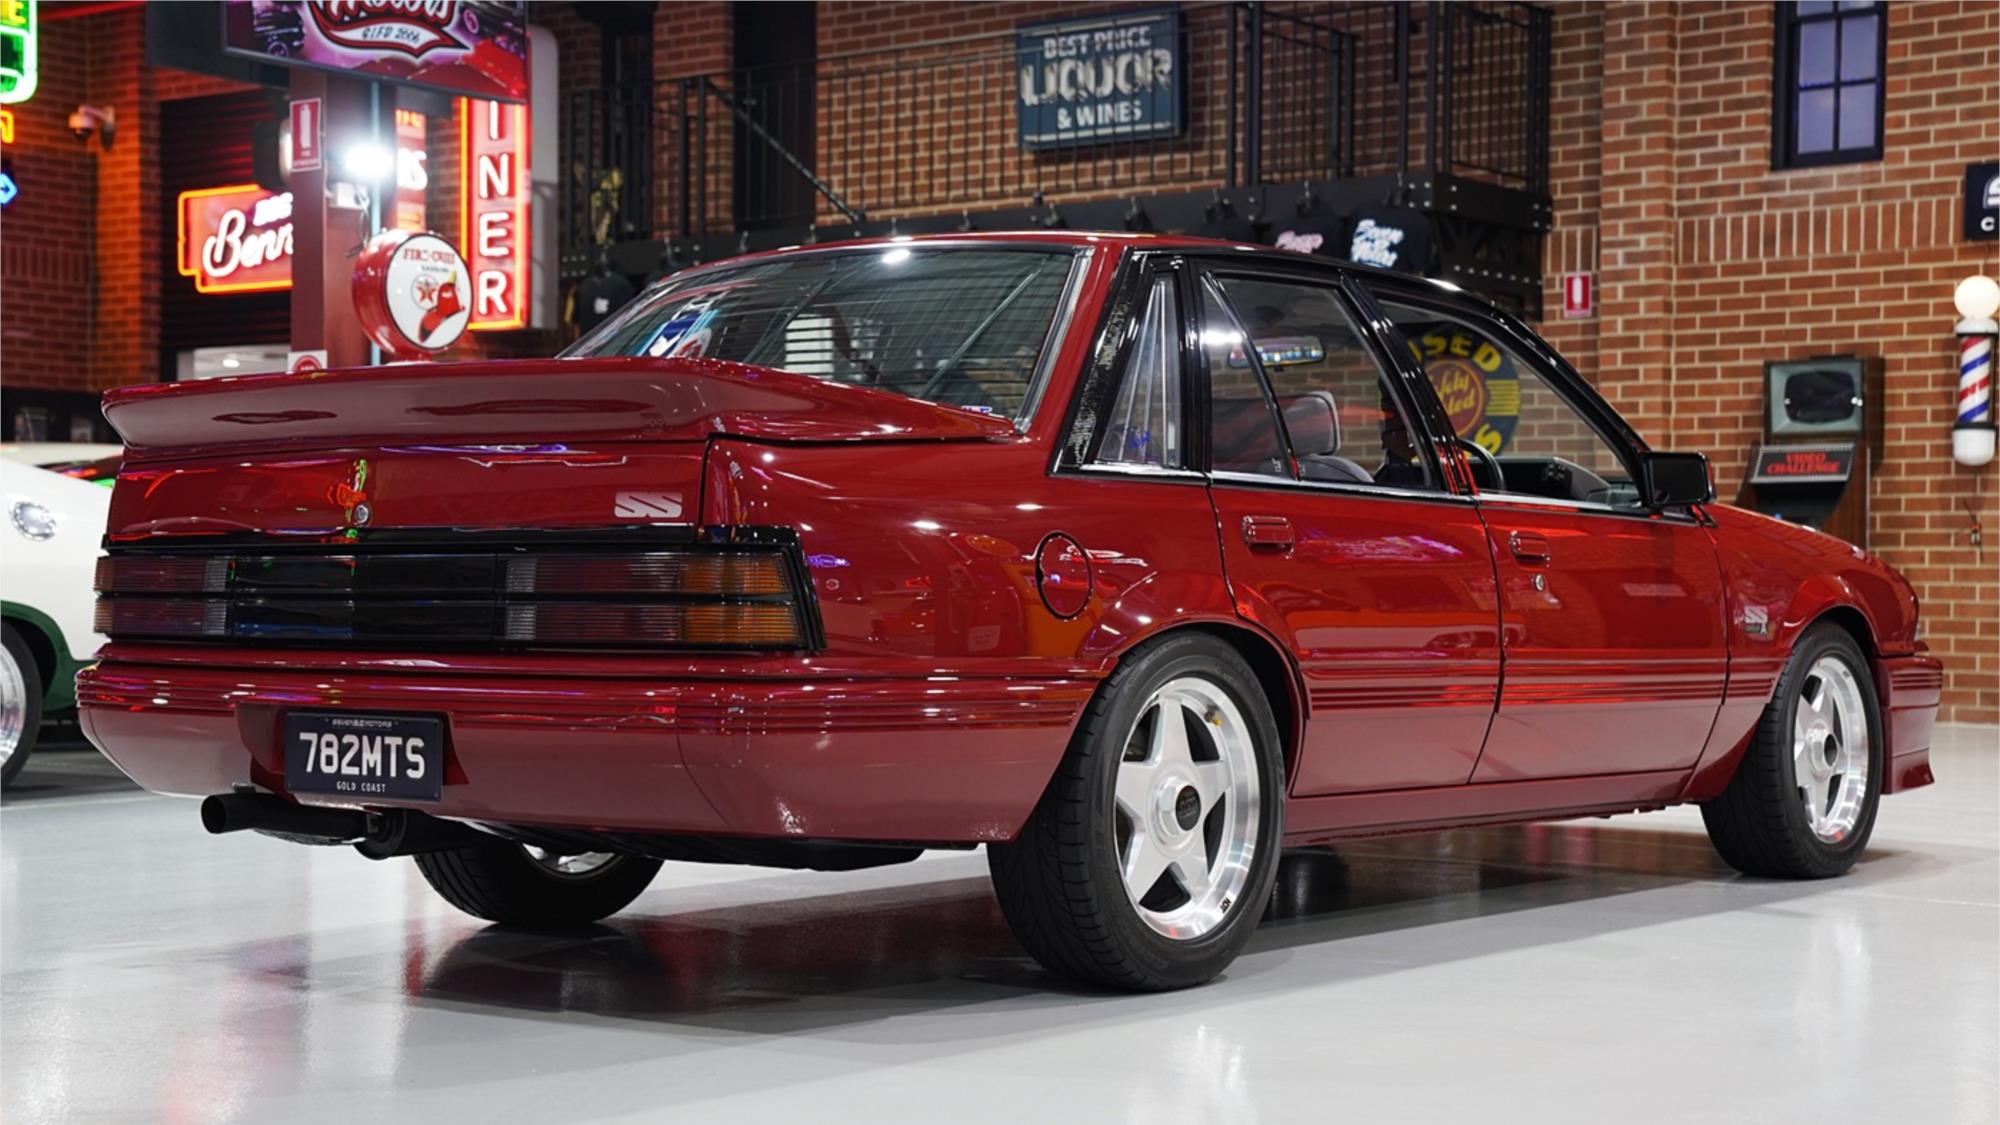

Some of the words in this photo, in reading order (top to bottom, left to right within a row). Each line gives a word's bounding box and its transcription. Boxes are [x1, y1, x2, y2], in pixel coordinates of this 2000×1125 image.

[1043, 33, 1090, 59] BEST
[1094, 26, 1150, 52] PRICE
[1021, 49, 1172, 106] LIQUOR
[1057, 107, 1072, 130] &
[1076, 100, 1142, 127] WINES
[1767, 461, 1840, 475] CHALLENGE
[1785, 452, 1826, 464] VIDEO
[614, 491, 682, 518] SS
[300, 732, 425, 779] 782MTS
[336, 781, 356, 791] GOLD
[361, 782, 386, 793] COAST
